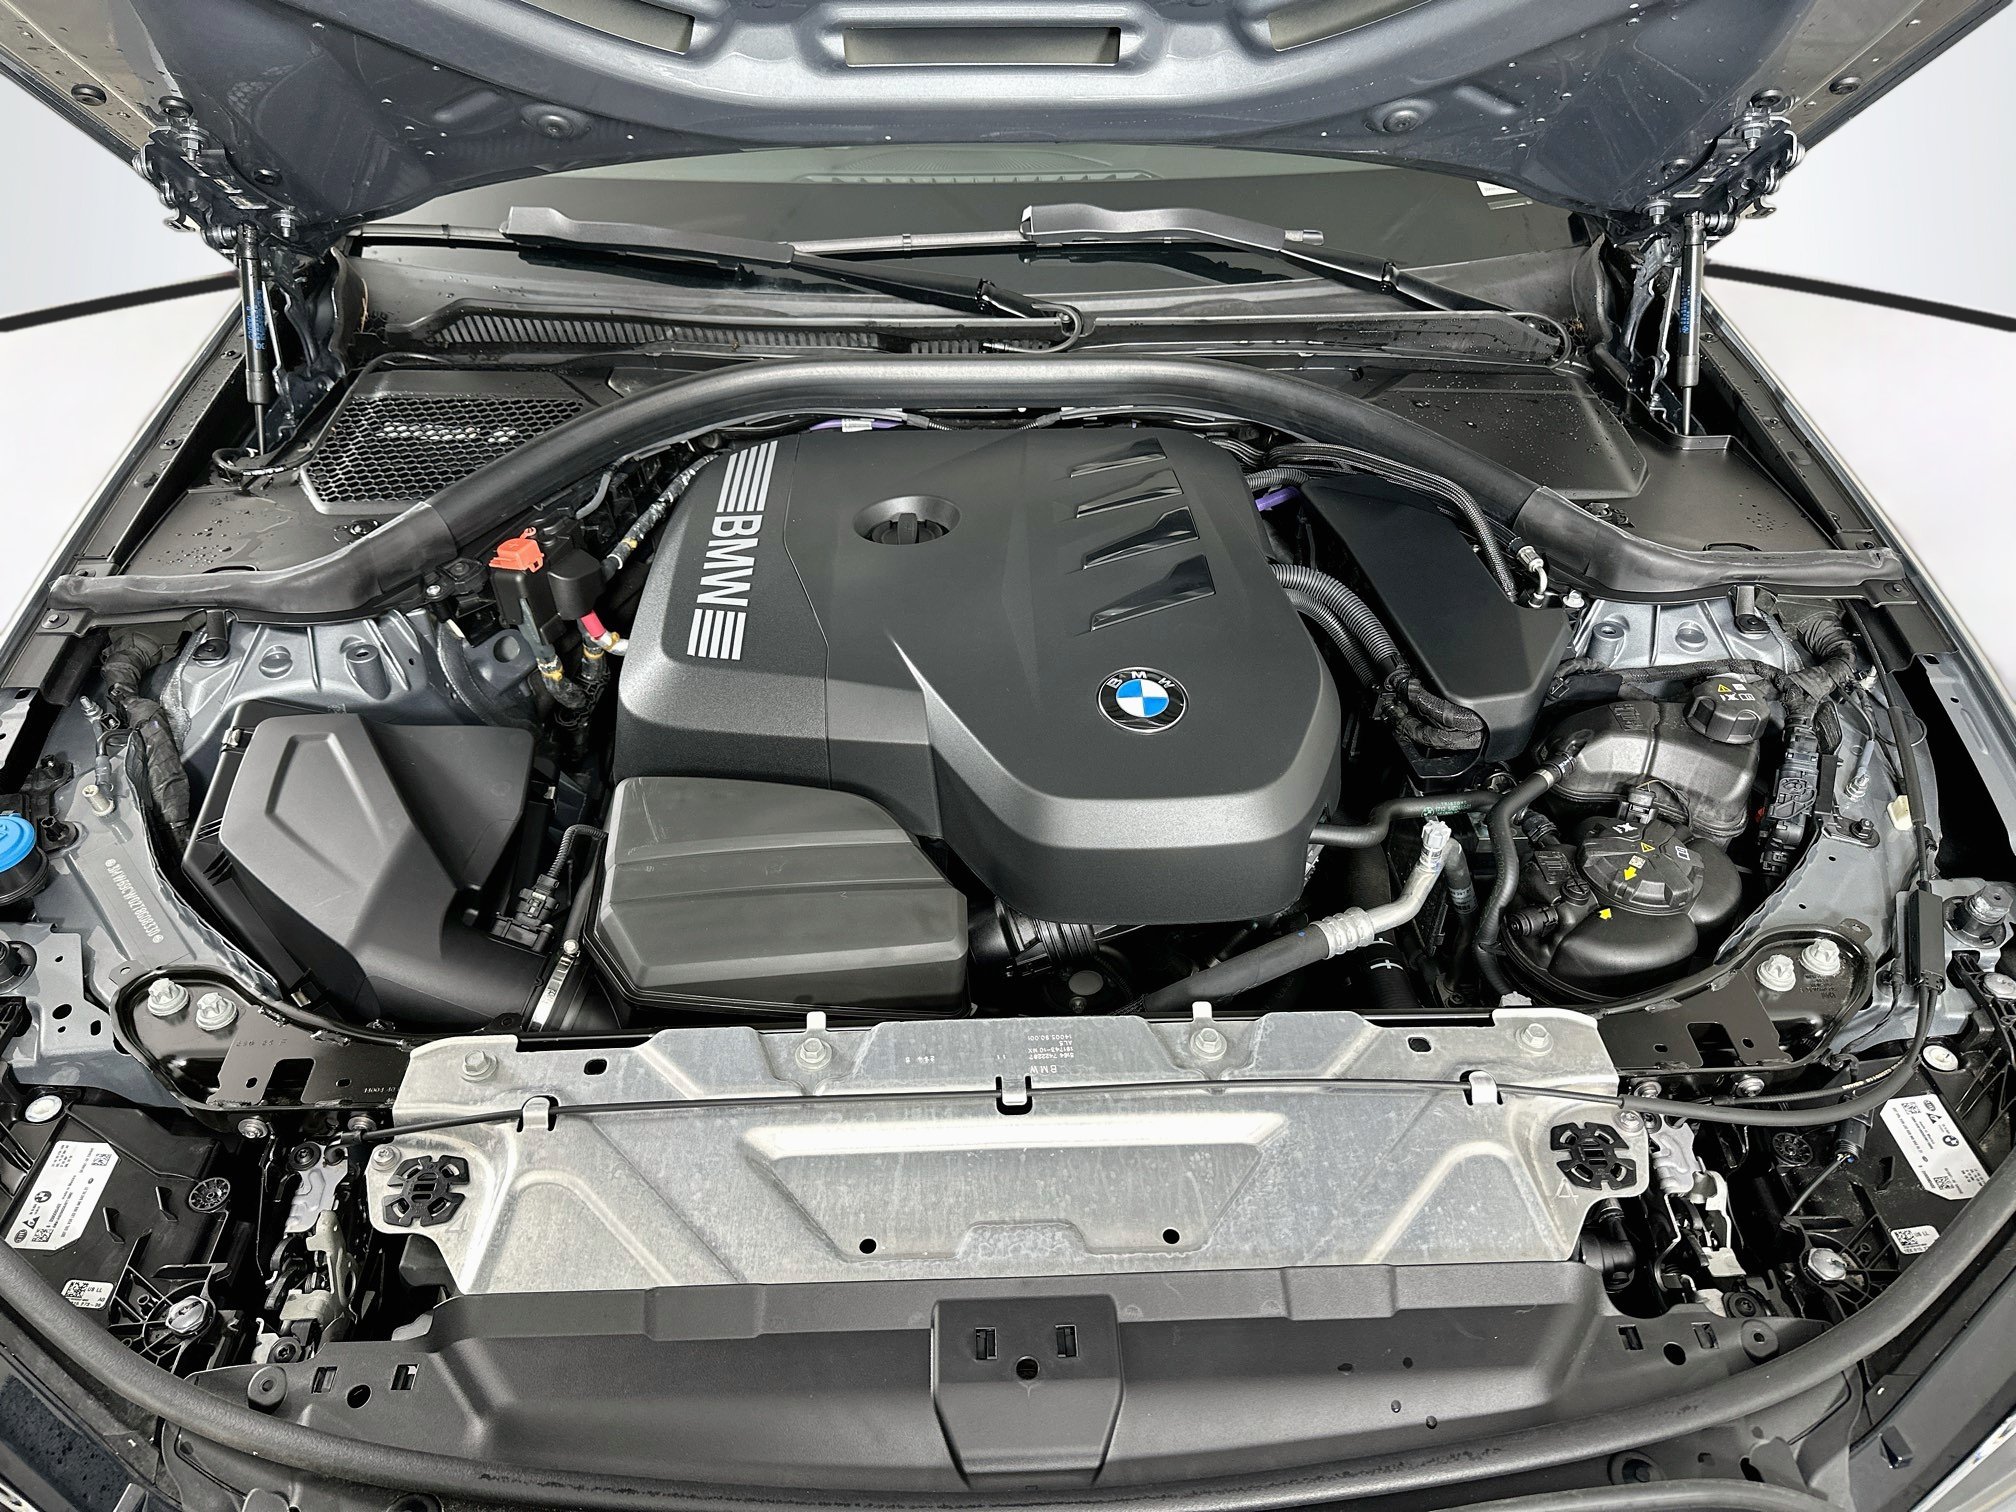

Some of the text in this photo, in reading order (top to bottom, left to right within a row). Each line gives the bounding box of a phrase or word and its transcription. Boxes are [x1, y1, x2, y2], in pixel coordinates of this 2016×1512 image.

[697, 514, 763, 607] BMW
[1106, 671, 1175, 689] BMW
[1030, 1065, 1058, 1074] BMW
